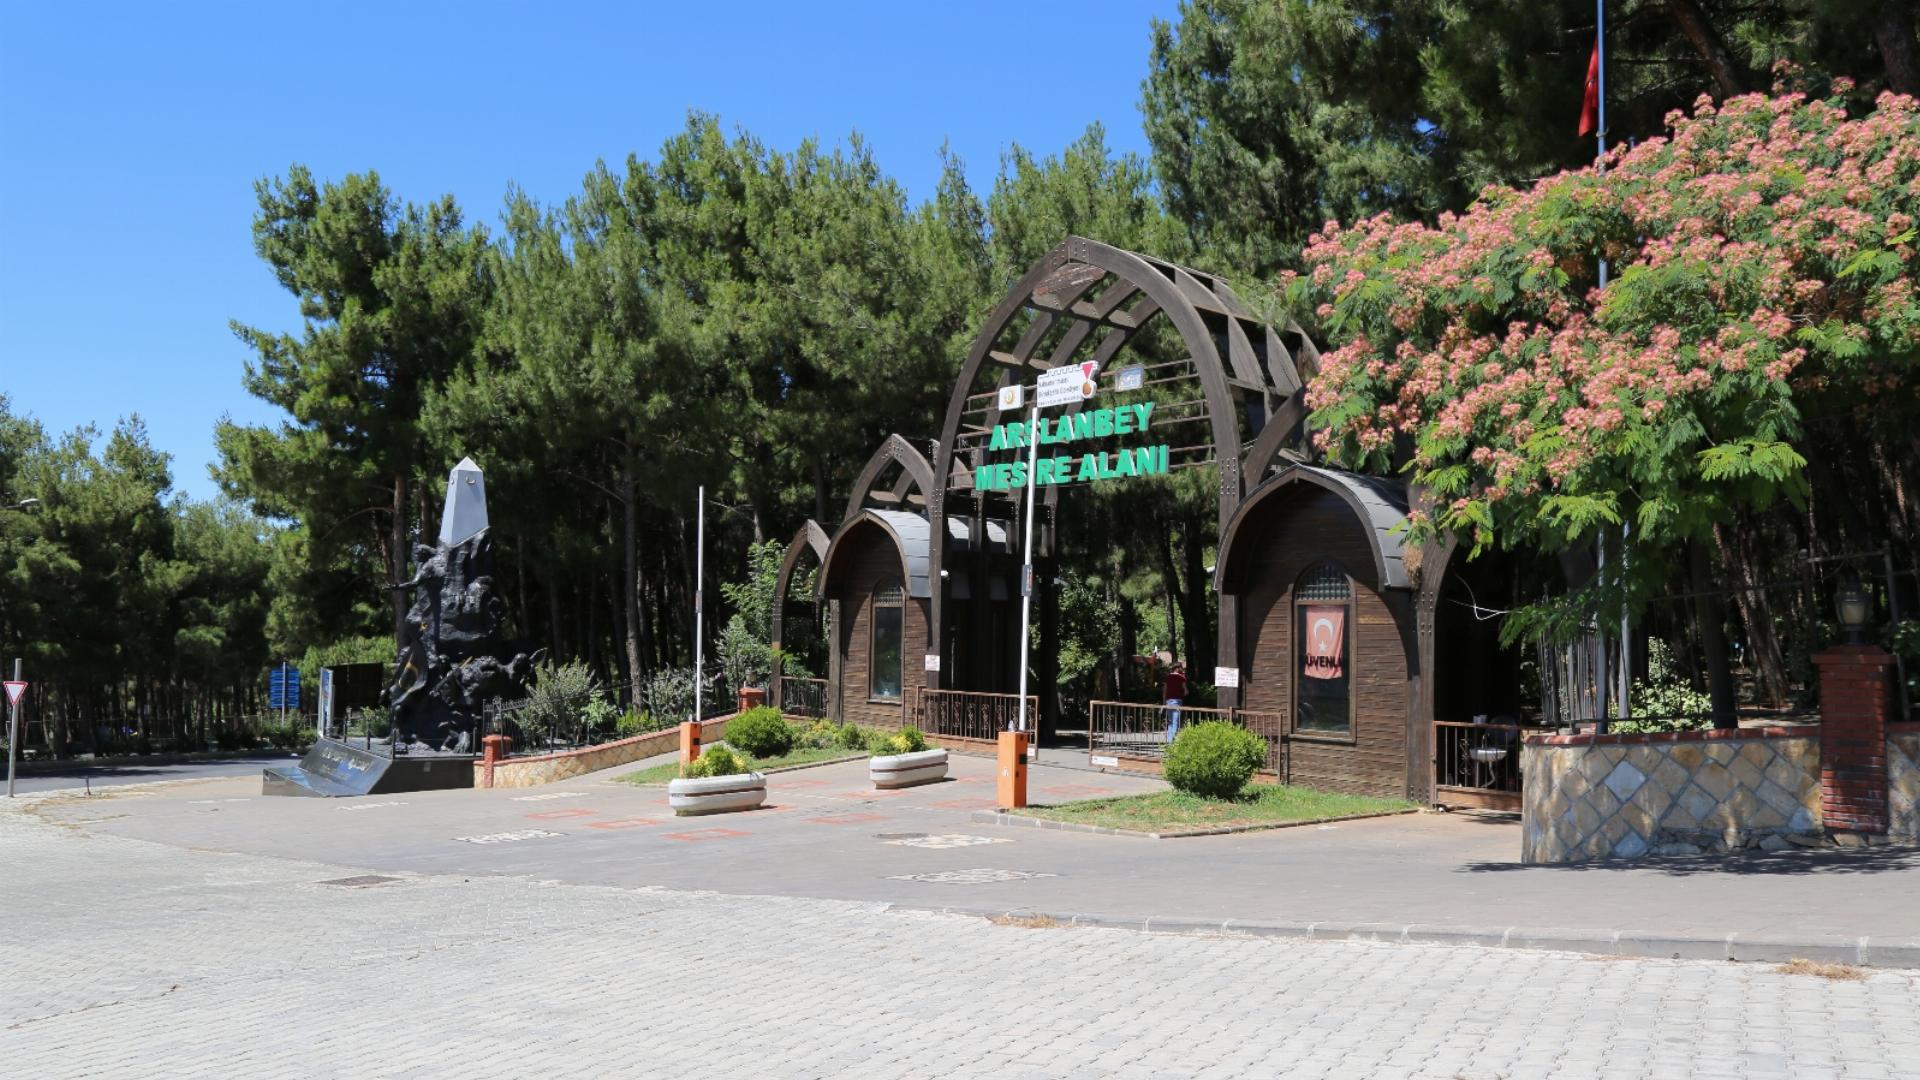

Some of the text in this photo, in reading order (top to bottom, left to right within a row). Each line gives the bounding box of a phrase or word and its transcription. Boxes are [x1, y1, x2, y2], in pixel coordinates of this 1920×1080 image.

[989, 402, 1154, 451] ARSLANBEY
[975, 444, 1168, 491] MESRE ALANI
